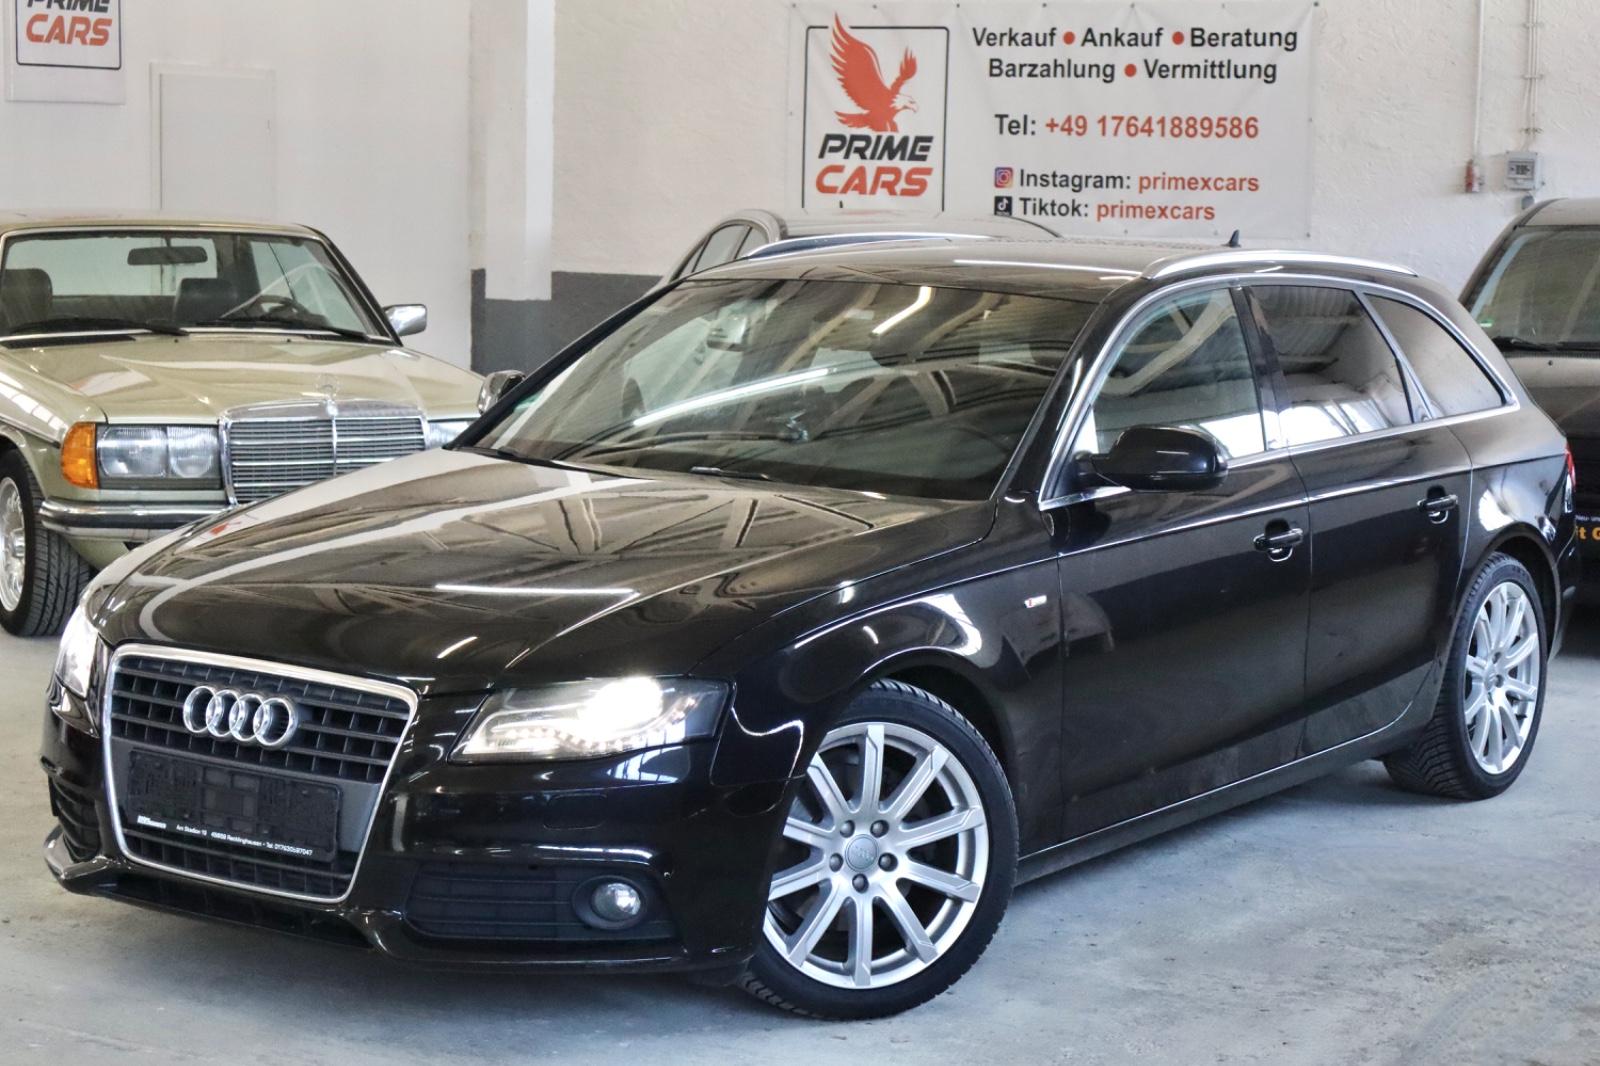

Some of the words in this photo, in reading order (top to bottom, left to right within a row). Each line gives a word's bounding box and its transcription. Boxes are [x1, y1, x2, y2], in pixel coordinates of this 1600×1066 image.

[26, 13, 113, 46] CARS
[972, 27, 1057, 47] Verkauf
[1080, 27, 1164, 48] Ankauf
[1190, 27, 1298, 52] Beratung
[989, 58, 1115, 84] Barzahlung
[1143, 58, 1277, 85] Vermittlung
[994, 113, 1037, 136] Tel:
[1045, 115, 1088, 137] +49
[1097, 115, 1259, 139] 17641889586
[818, 132, 934, 162] PRIME
[815, 164, 933, 197] CARS
[1020, 168, 1131, 193] Instagram:
[1138, 172, 1259, 194] primexcars
[1018, 197, 1088, 217] Tiktok:
[1096, 202, 1215, 222] primexcars
